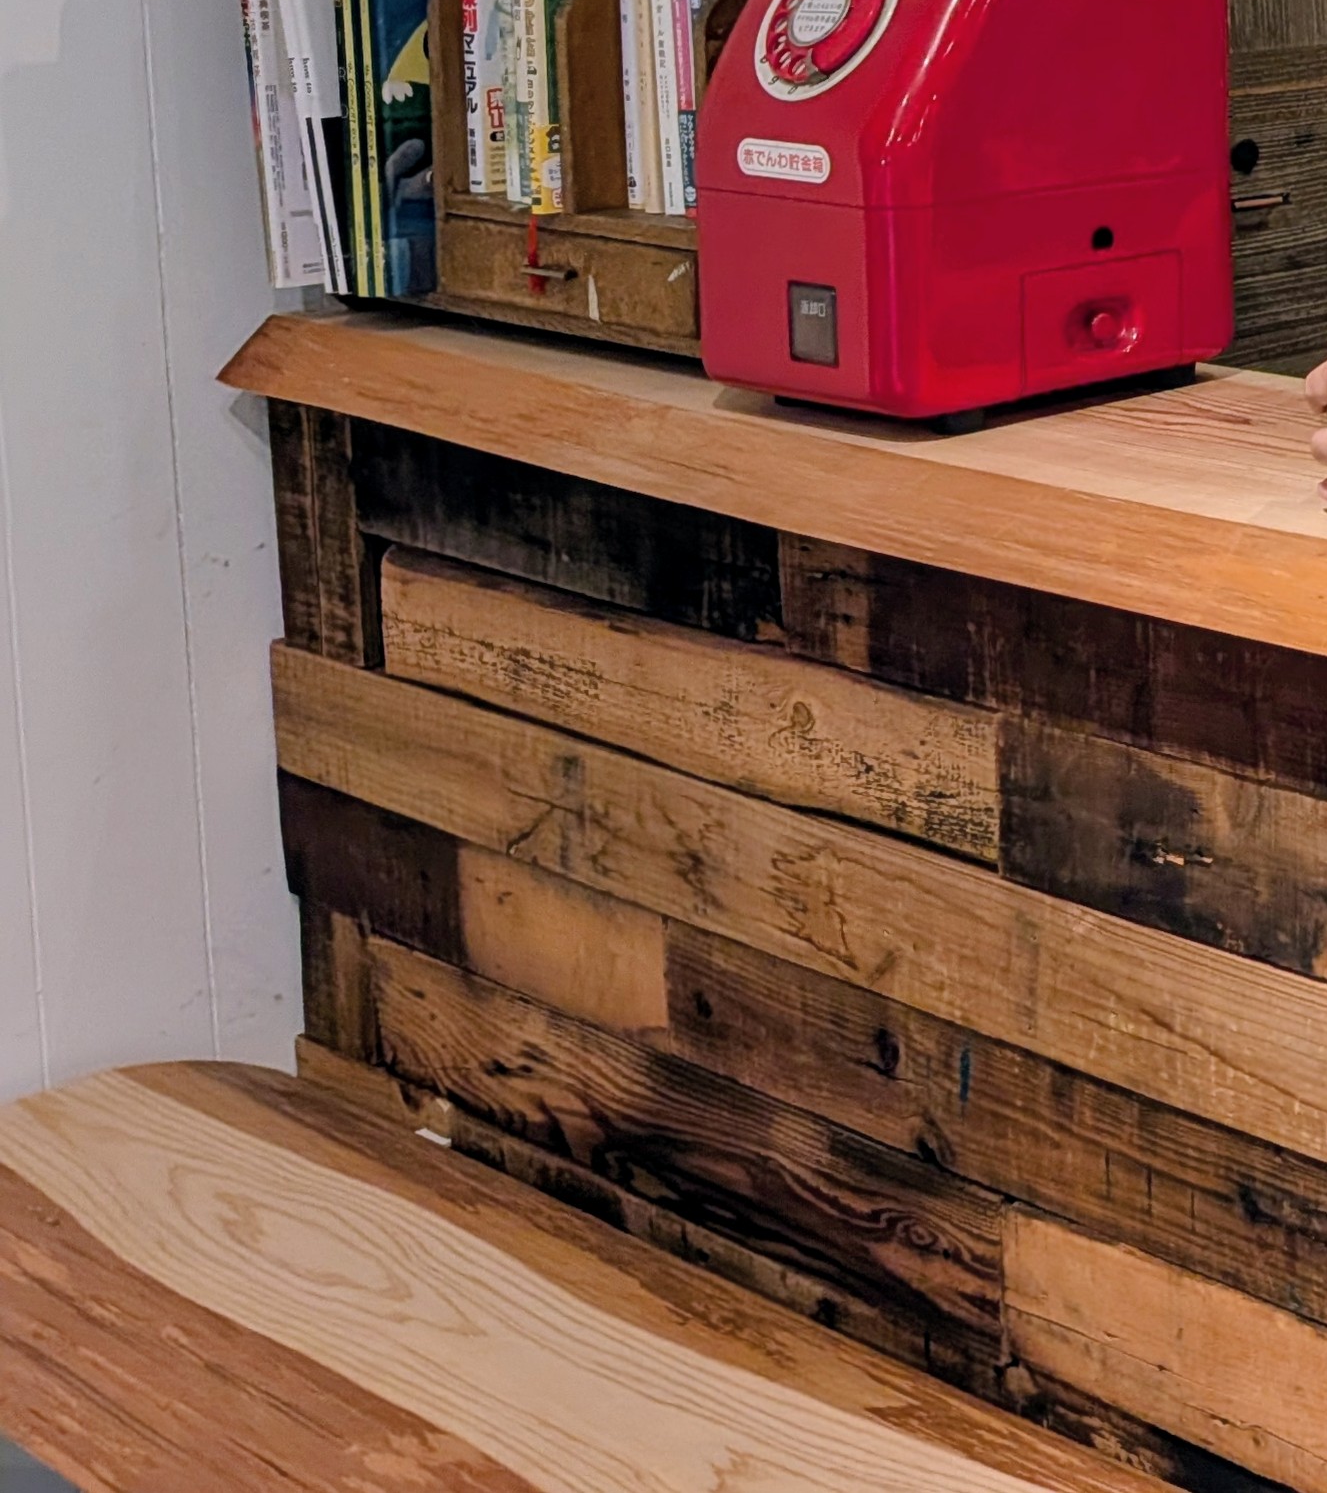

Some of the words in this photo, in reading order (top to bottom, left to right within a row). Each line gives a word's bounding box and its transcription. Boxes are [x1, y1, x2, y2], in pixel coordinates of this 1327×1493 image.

[743, 148, 825, 174] 赤でんわ貯金箱
